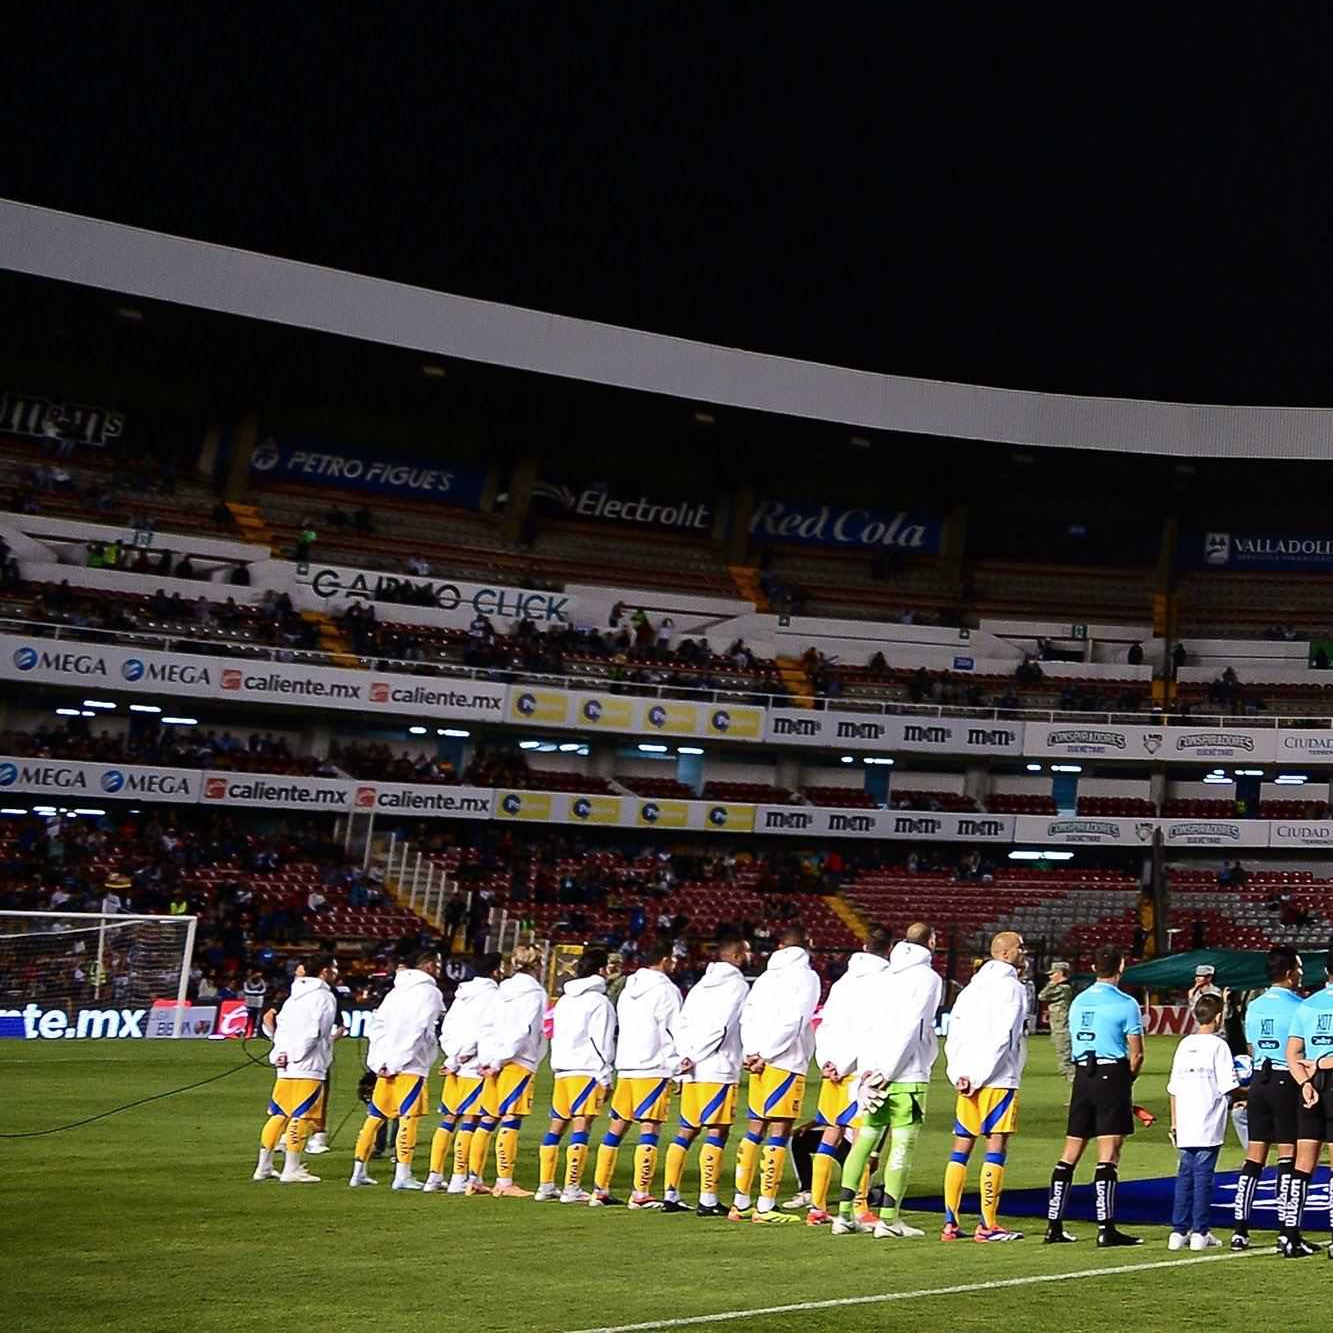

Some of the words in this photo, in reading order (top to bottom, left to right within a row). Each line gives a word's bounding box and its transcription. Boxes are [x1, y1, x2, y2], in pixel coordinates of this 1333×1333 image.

[288, 449, 364, 478] PETRO
[575, 490, 710, 530] Electrolit
[750, 499, 830, 540] Red
[832, 508, 927, 548] Cola
[472, 588, 568, 621] CLICK
[40, 651, 108, 676] MEGA
[150, 664, 211, 685] MEGA
[244, 673, 361, 700] caliente.mx
[391, 686, 502, 711] caliente.mx
[1048, 730, 1126, 749] CONSPIRADORES
[1176, 733, 1255, 752] CONSPIRADORES
[19, 767, 86, 788] MEGA
[123, 775, 191, 795] MEGA
[228, 780, 348, 805] caliente.mx
[378, 791, 490, 814] caliente.mx
[1168, 824, 1240, 839] CONSPIRADORES
[1277, 826, 1329, 838] CIUDAD
